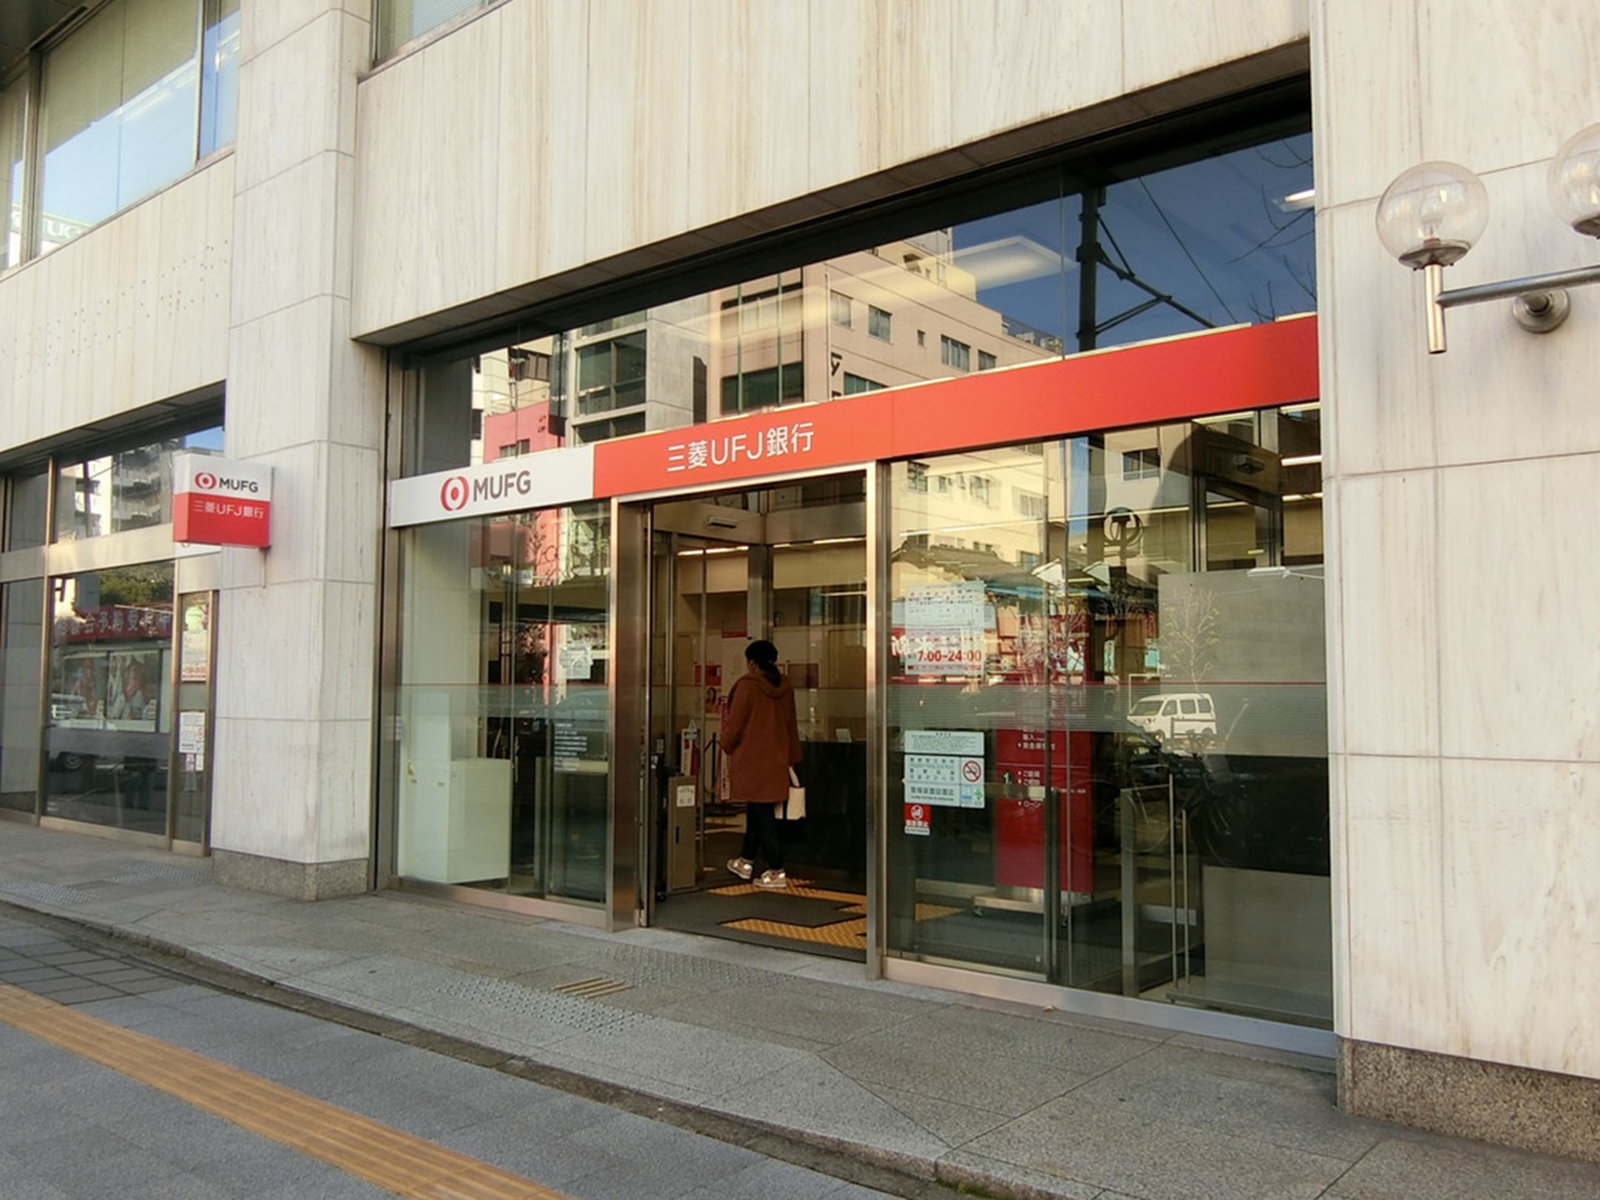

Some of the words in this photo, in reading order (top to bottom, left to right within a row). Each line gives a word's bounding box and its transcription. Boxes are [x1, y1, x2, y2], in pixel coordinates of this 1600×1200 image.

[667, 421, 814, 472] 三菱UFJ銀行
[219, 477, 259, 493] MUFG
[473, 470, 532, 502] MUFG
[193, 500, 265, 519] 三菱UFJ銀行
